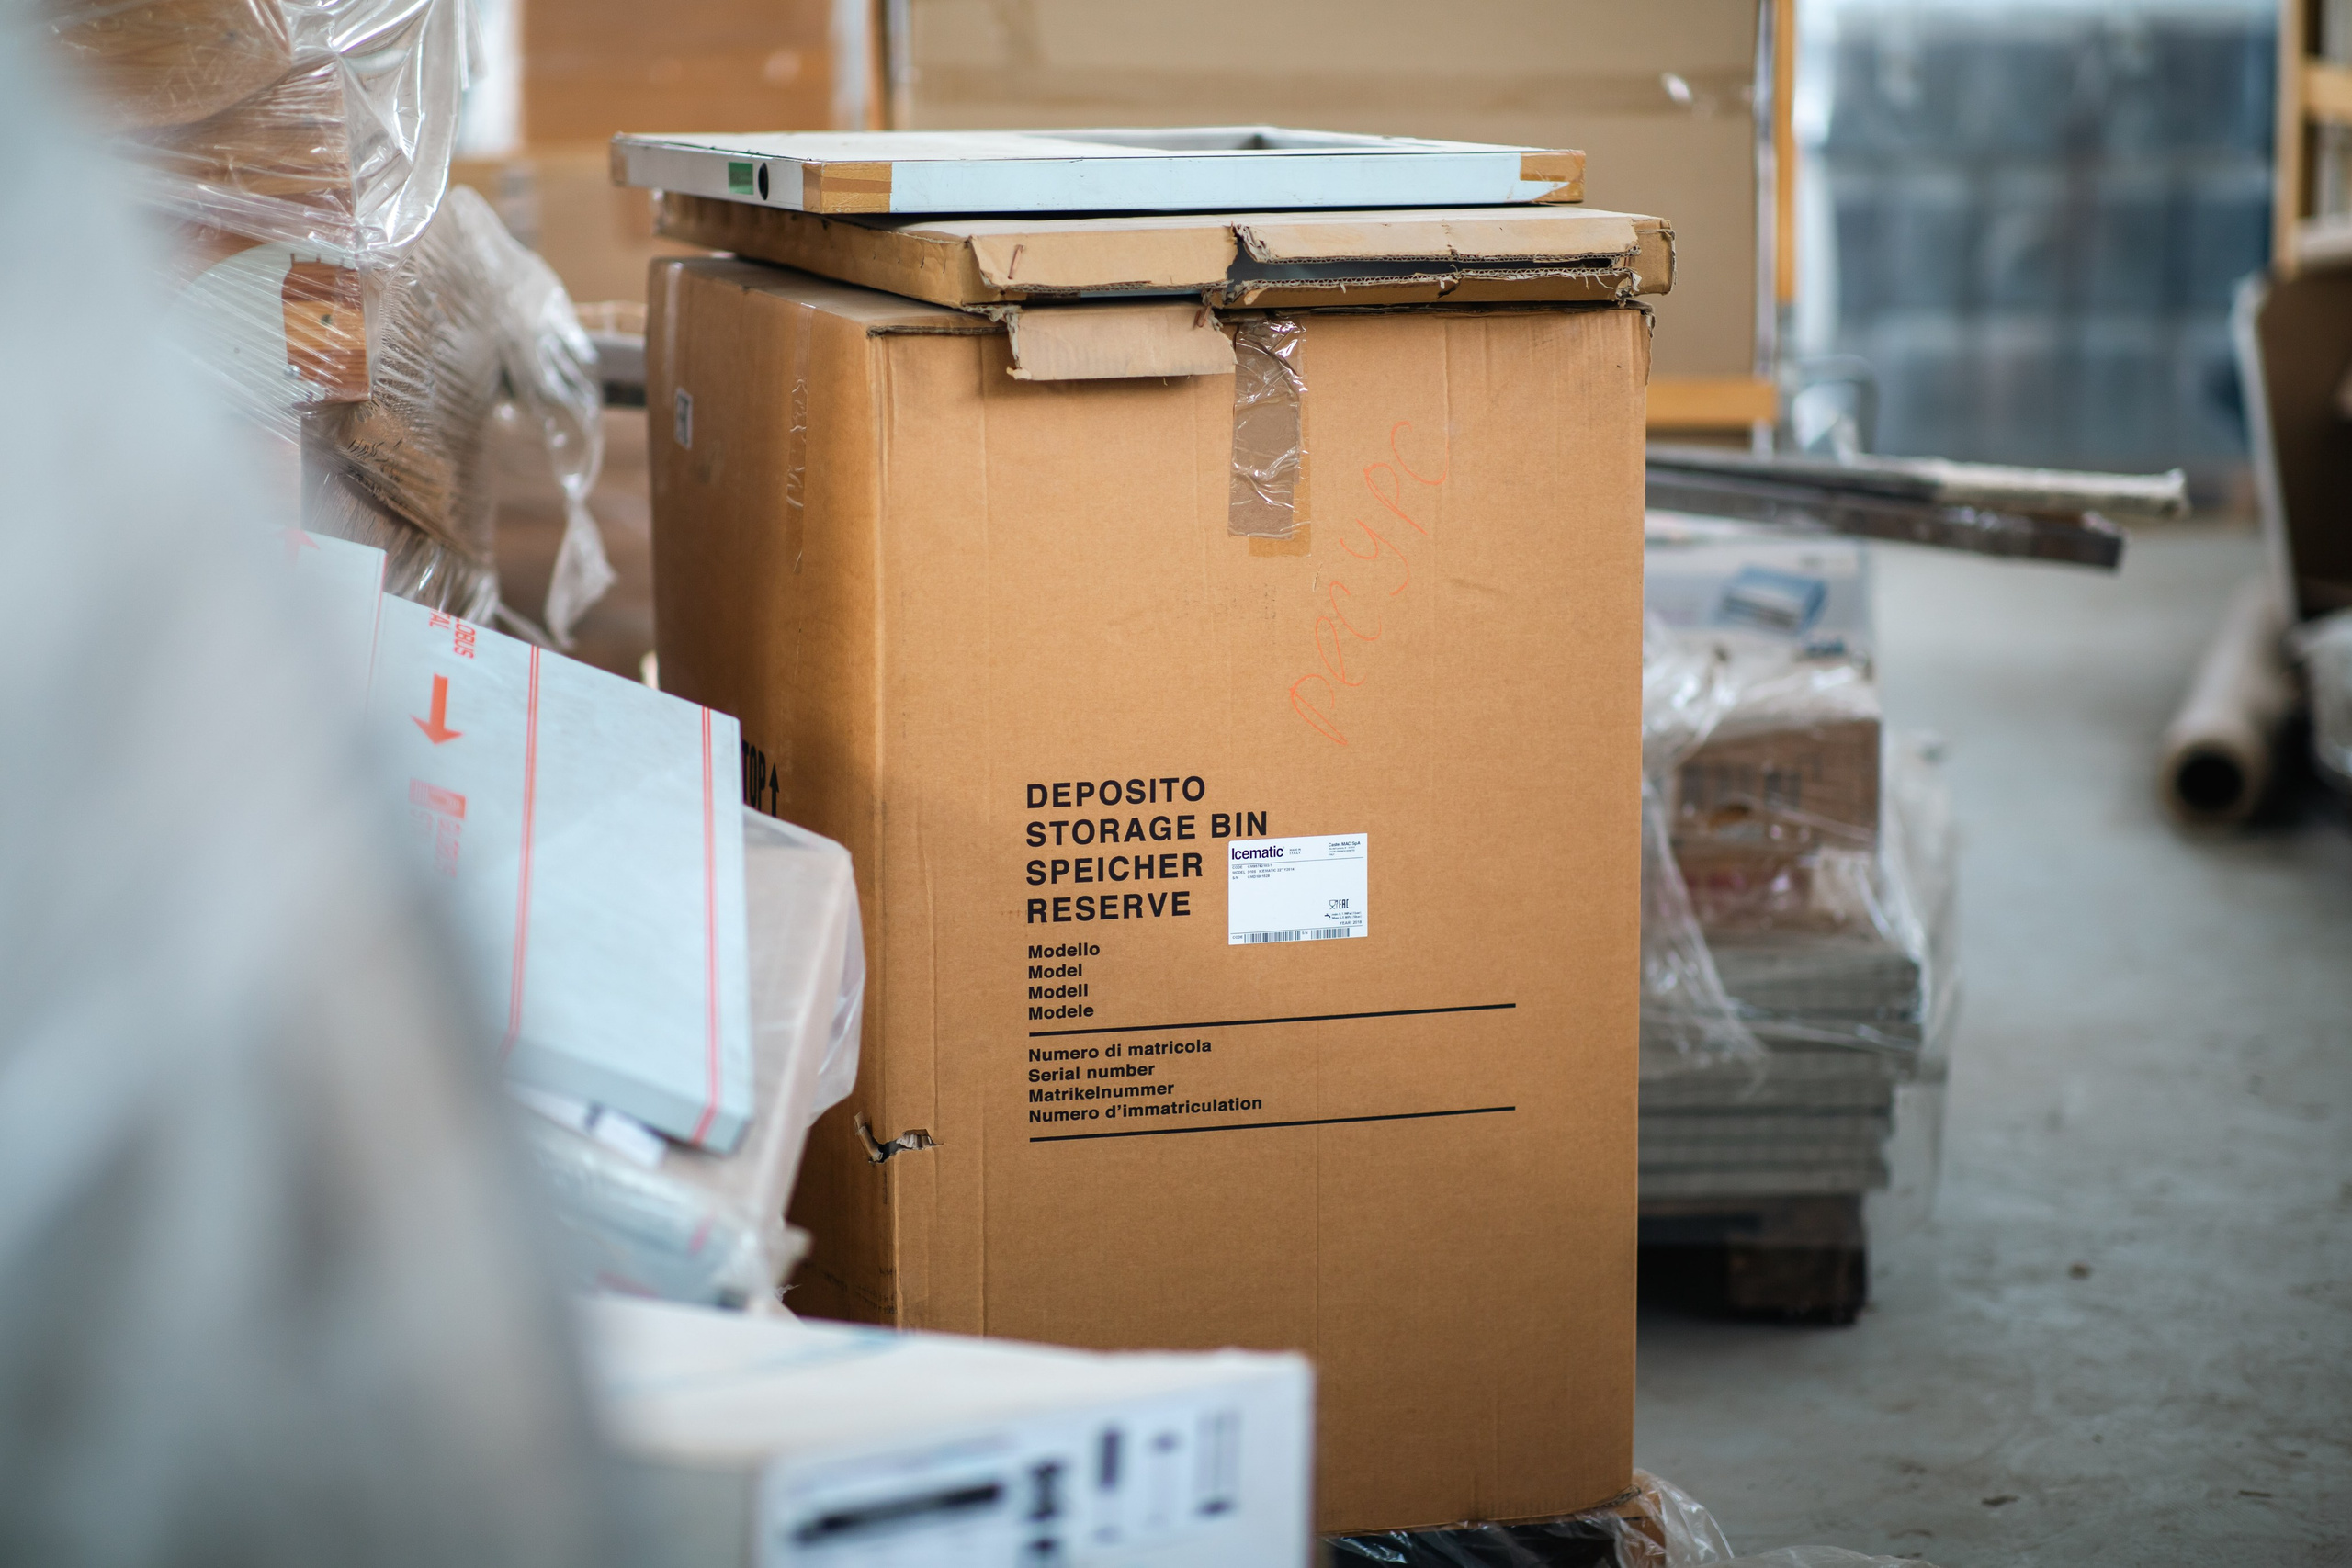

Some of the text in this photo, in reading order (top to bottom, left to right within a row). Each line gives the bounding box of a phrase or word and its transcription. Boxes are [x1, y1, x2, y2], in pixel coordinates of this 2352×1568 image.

[1026, 776, 1205, 809] DEPOSITO
[1025, 810, 1267, 848] STORAGE BIN
[1231, 845, 1284, 861] Icematic
[1025, 853, 1203, 886] SPEICHER
[1027, 891, 1191, 924] RESERVE
[1028, 942, 1101, 959] Modello
[1028, 963, 1083, 980] Model
[1028, 983, 1089, 1000] Modell
[1028, 1003, 1095, 1021] Modele
[1028, 1039, 1213, 1063] Numero di matricola
[1028, 1063, 1156, 1084] Serial number
[1028, 1083, 1175, 1103] Matrikelnummer
[1029, 1108, 1100, 1123] Numero
